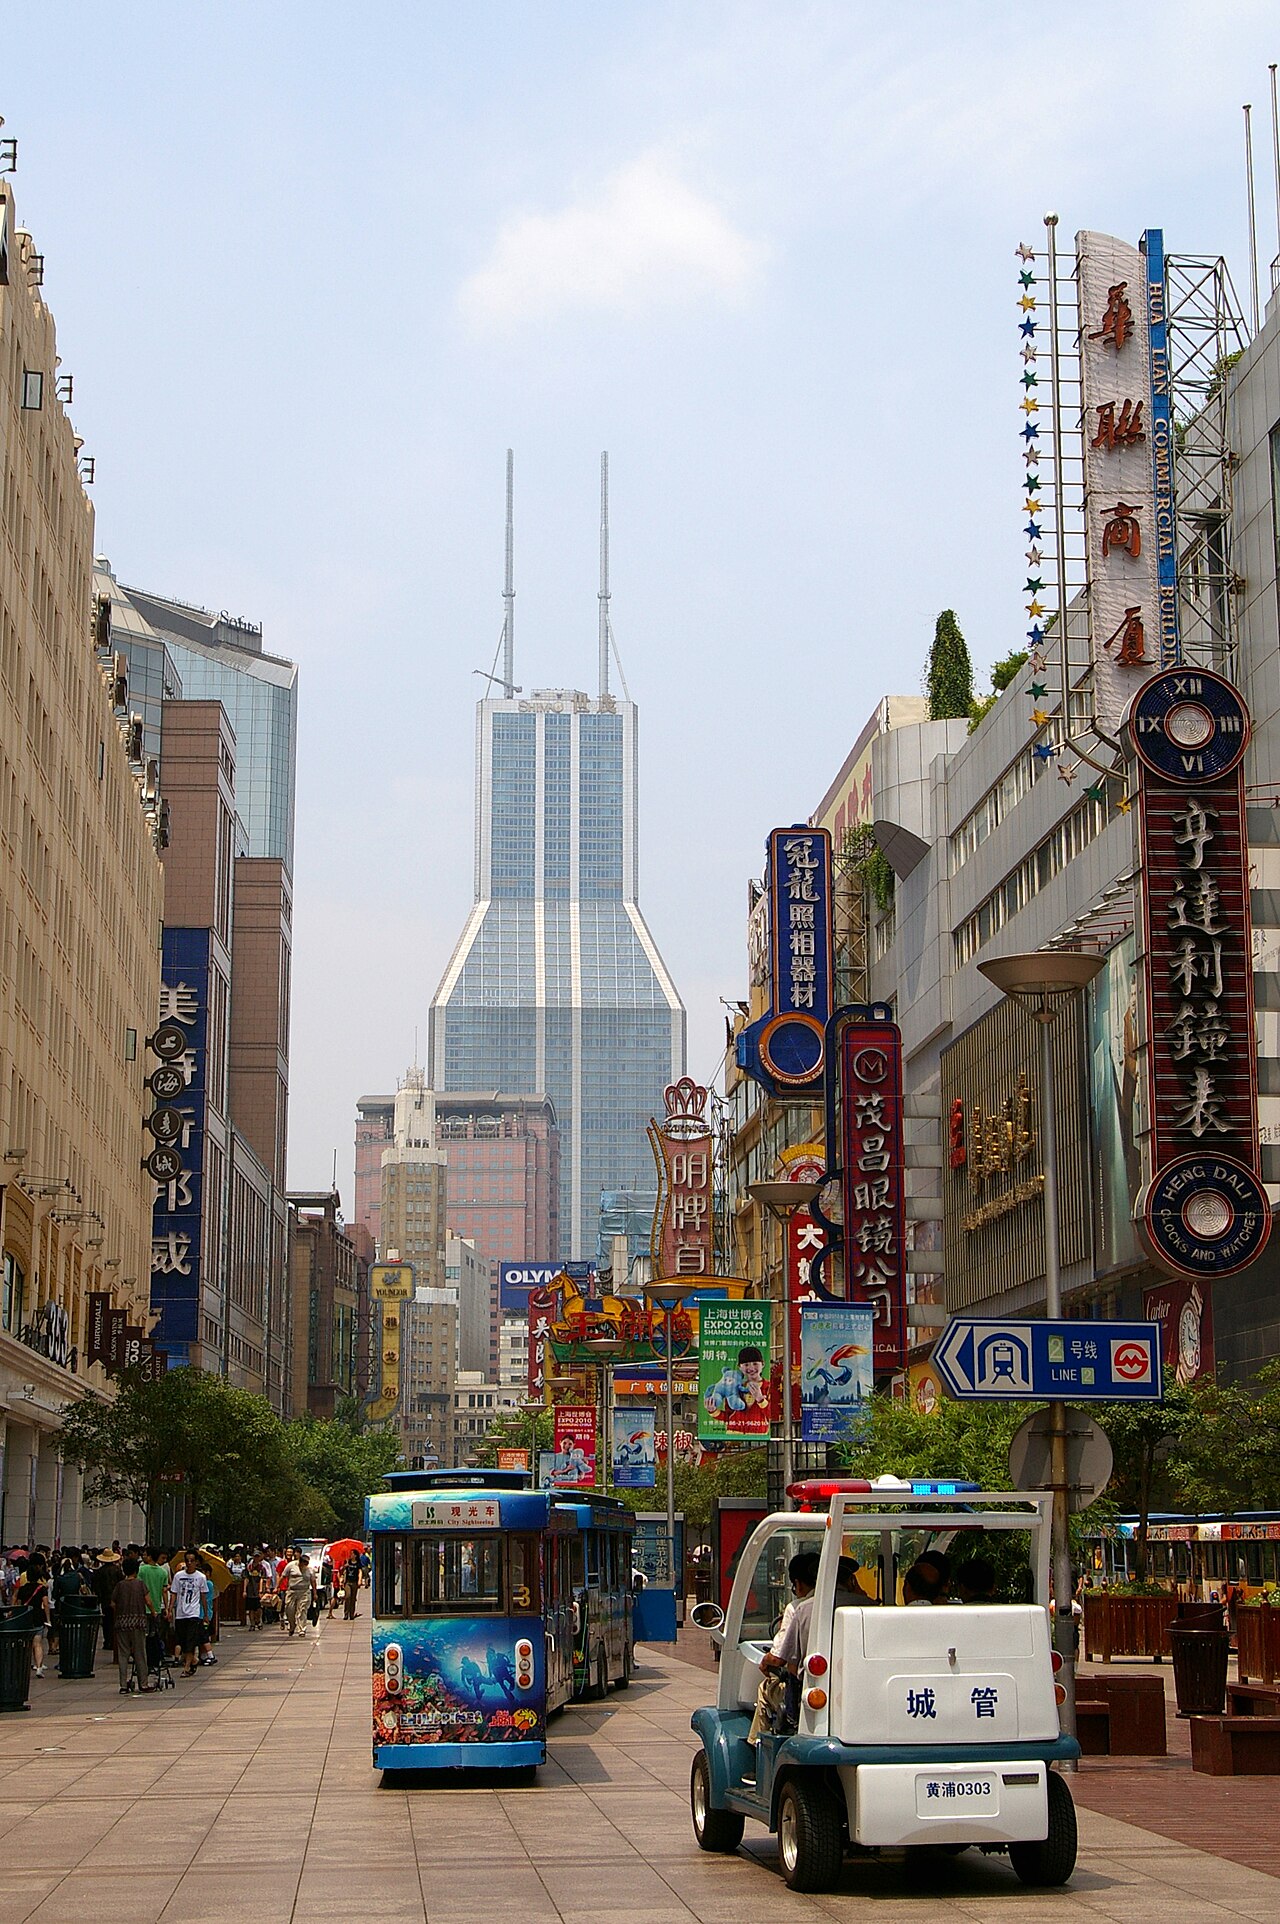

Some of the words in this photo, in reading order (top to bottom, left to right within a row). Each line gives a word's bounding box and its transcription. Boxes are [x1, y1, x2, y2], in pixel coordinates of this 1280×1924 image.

[1149, 281, 1164, 325] HUA
[1152, 347, 1168, 395] LIAN
[1154, 418, 1173, 561] COMMERCIAL
[220, 608, 264, 638] Sofitel
[1174, 678, 1202, 695] XII
[1181, 755, 1204, 772] VI
[1162, 1165, 1207, 1201] HENG
[1212, 1165, 1253, 1201] DALI
[1160, 1208, 1189, 1254] CLOCKS
[1190, 1248, 1216, 1261] AND
[1221, 1211, 1257, 1259] WATCHES
[704, 1308, 764, 1320] 上海世博会
[1146, 1295, 1171, 1322] Cartier
[94, 1300, 102, 1350] FAIRWHALE
[704, 1321, 732, 1329] EXPO
[734, 1321, 764, 1329] 2010
[130, 1340, 140, 1364] OJO
[1049, 1338, 1063, 1360] 2
[1070, 1340, 1098, 1360] 号线
[1051, 1369, 1077, 1382] LINE
[1083, 1369, 1093, 1382] 2
[450, 1506, 495, 1517] 观光车
[518, 1586, 530, 1607] 3
[906, 1687, 998, 1719] 城管
[926, 1782, 991, 1798] 黄浦0303
